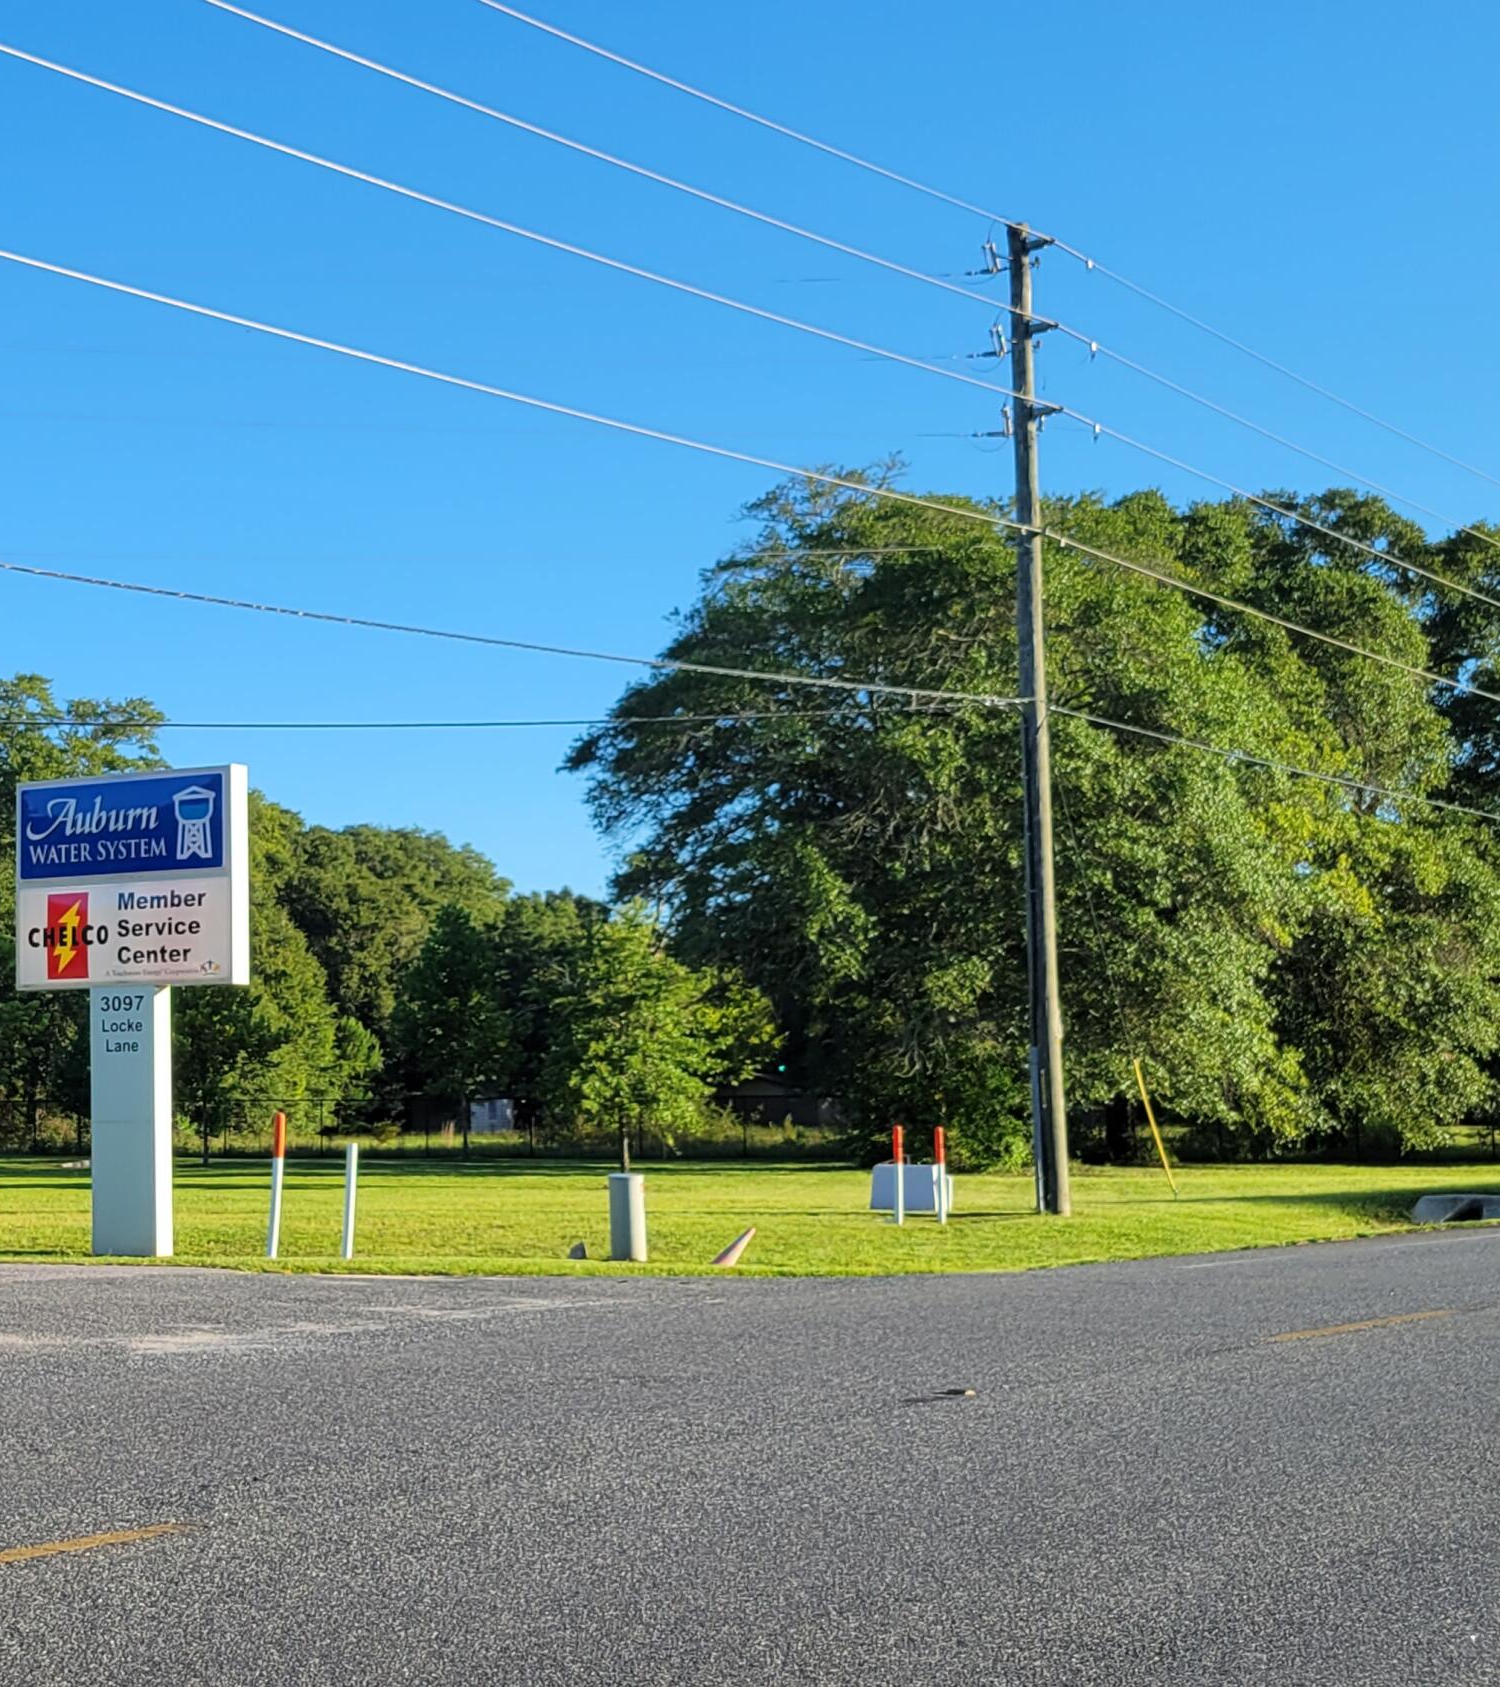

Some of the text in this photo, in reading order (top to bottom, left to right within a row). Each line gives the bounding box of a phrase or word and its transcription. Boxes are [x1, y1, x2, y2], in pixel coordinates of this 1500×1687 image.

[26, 795, 159, 841] Auburn
[29, 837, 167, 865] WATER SYSTEM
[117, 890, 206, 910] Member
[28, 925, 109, 948] CHELCO
[117, 917, 201, 937] Service
[117, 946, 192, 964] Center
[100, 995, 145, 1012] 3097
[102, 1018, 143, 1032] Locke
[106, 1039, 139, 1052] Lane
